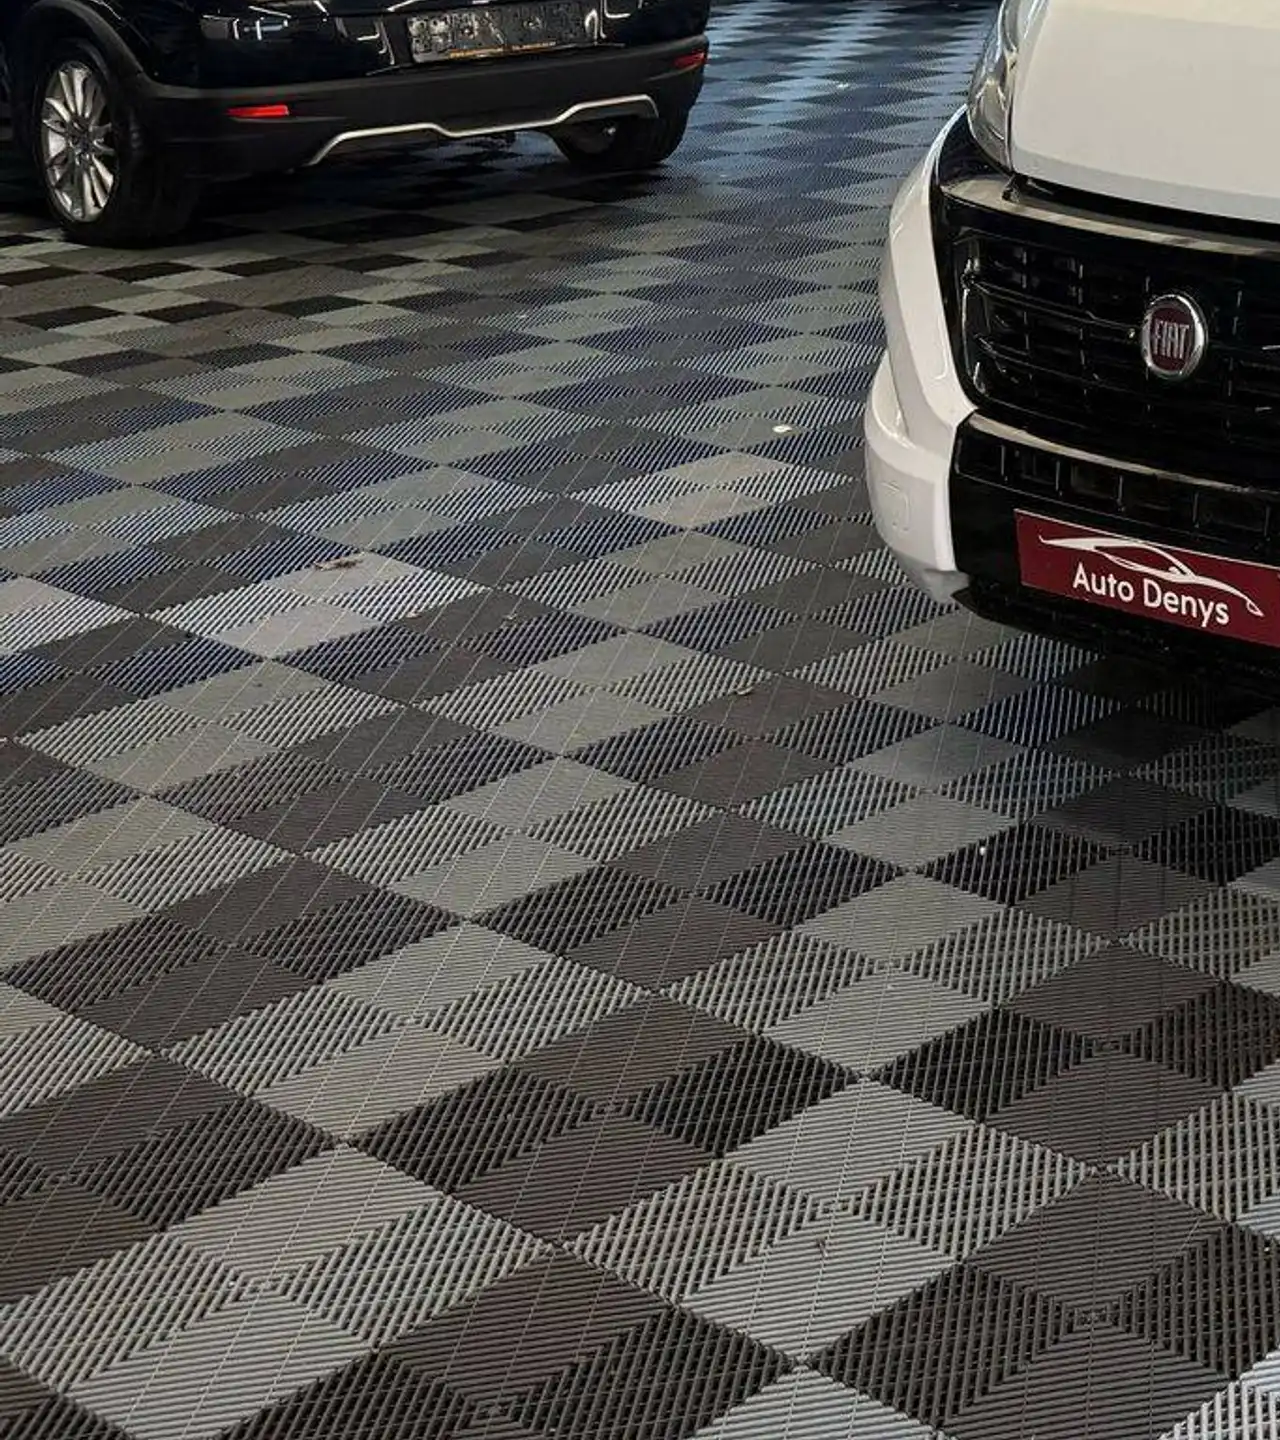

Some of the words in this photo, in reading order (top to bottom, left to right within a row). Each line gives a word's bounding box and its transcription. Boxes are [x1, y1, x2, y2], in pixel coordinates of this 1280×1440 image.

[1153, 319, 1190, 359] FIAT
[1072, 561, 1134, 603] Auto
[1143, 578, 1230, 628] Denys
